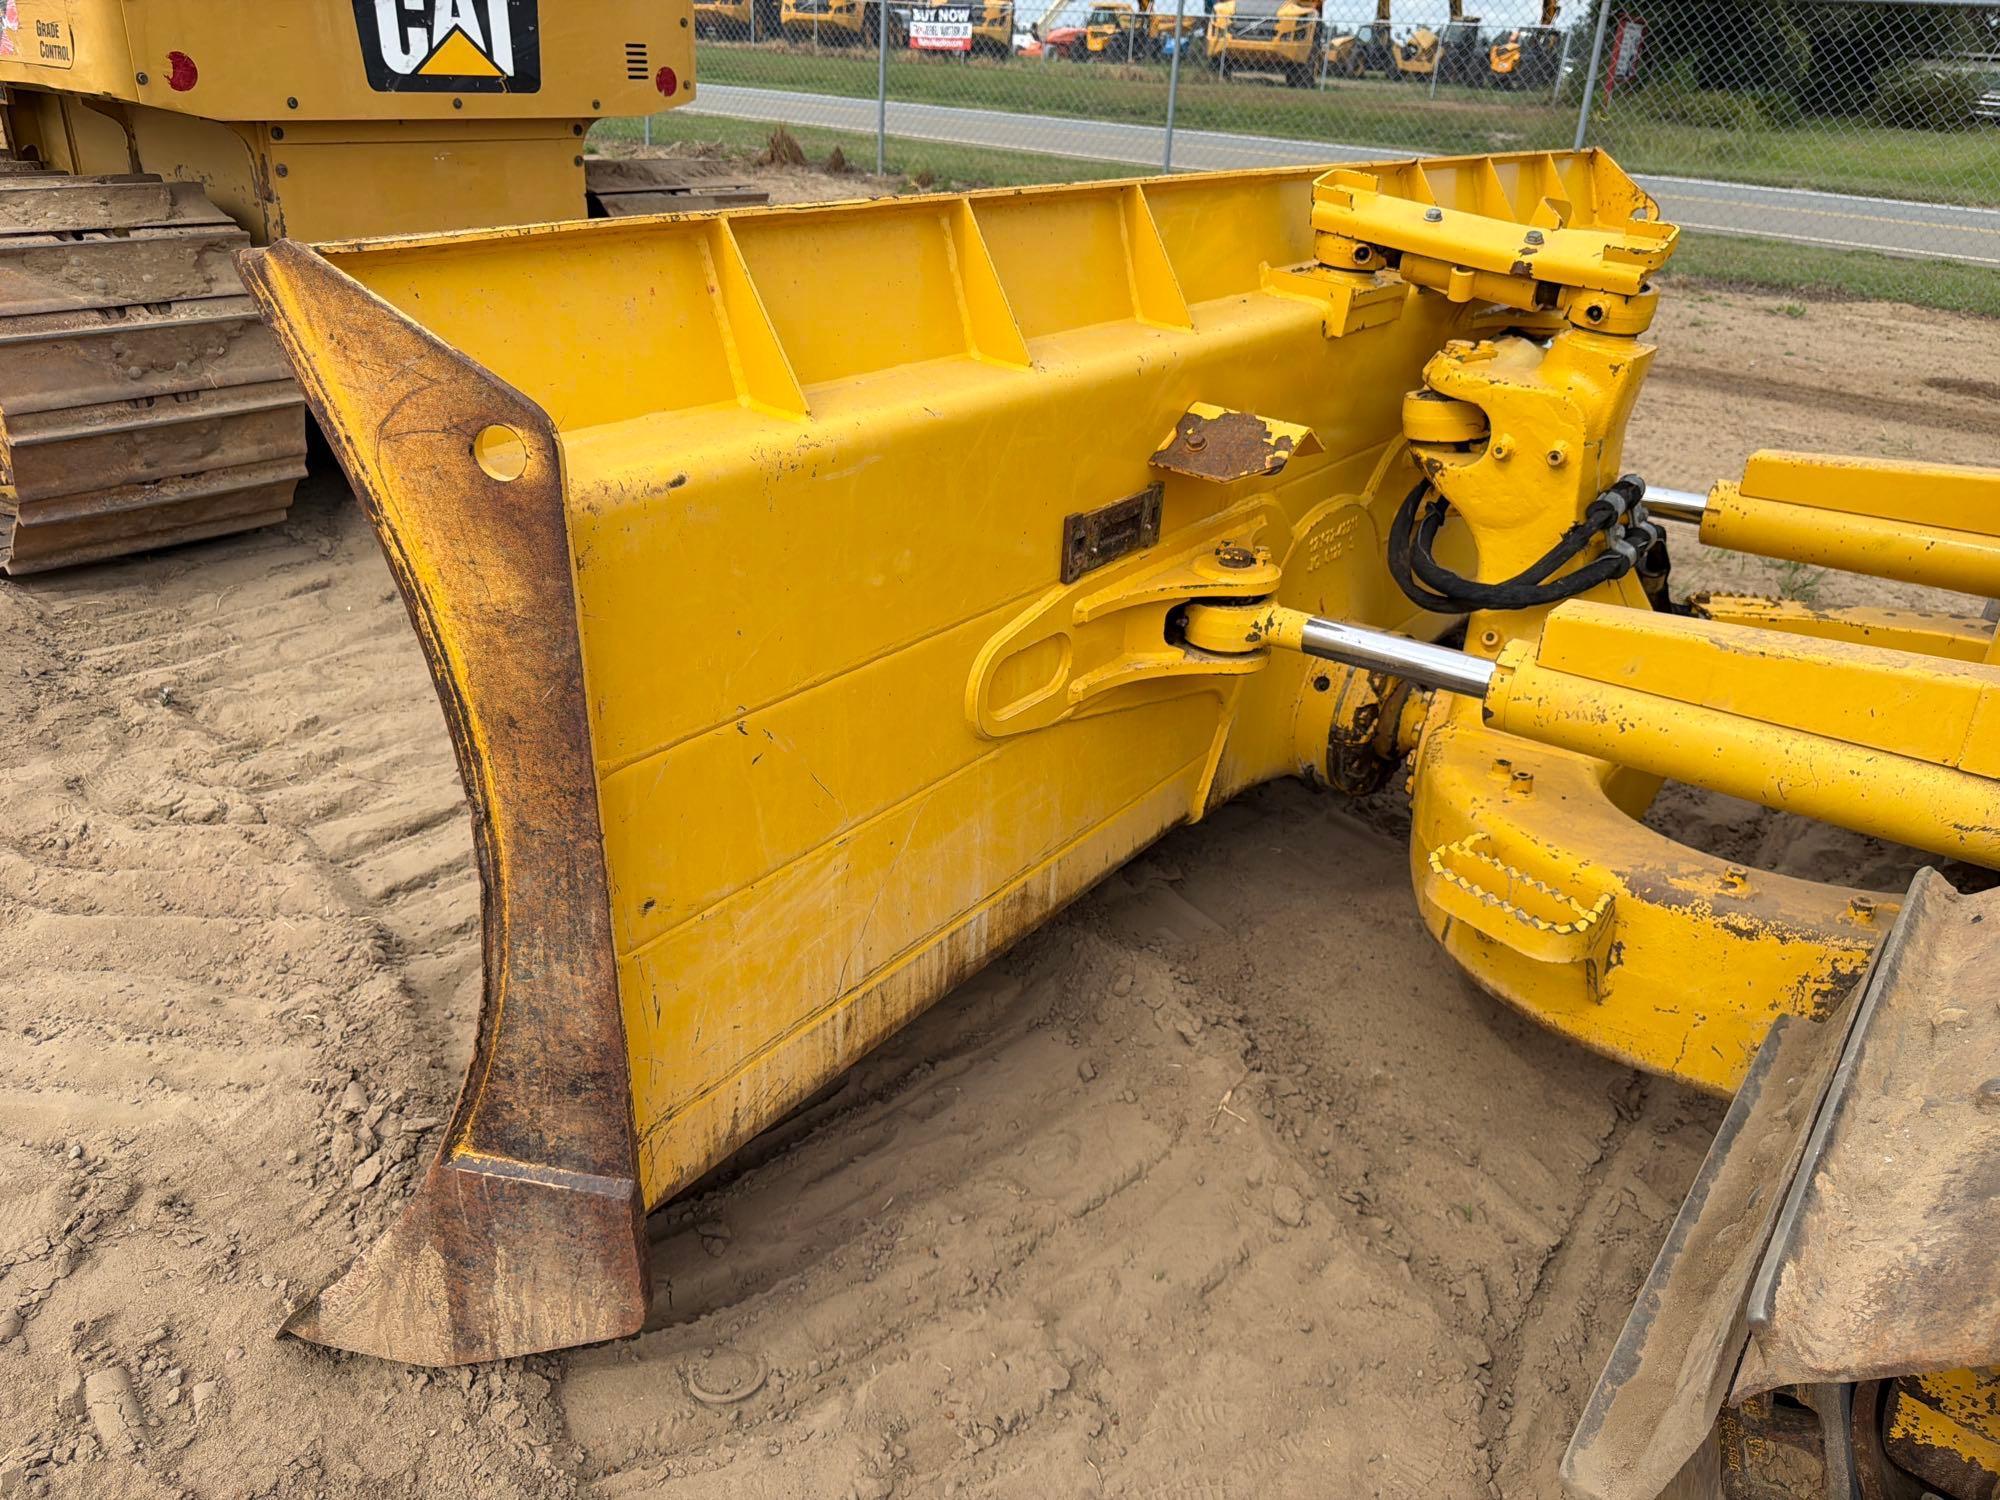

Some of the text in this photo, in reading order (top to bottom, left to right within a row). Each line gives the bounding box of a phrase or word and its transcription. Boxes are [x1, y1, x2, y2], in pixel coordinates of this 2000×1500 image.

[912, 8, 969, 21] BUY NOW
[36, 19, 59, 38] GRADE
[374, 0, 515, 77] CAT
[40, 40, 70, 60] CONTROL
